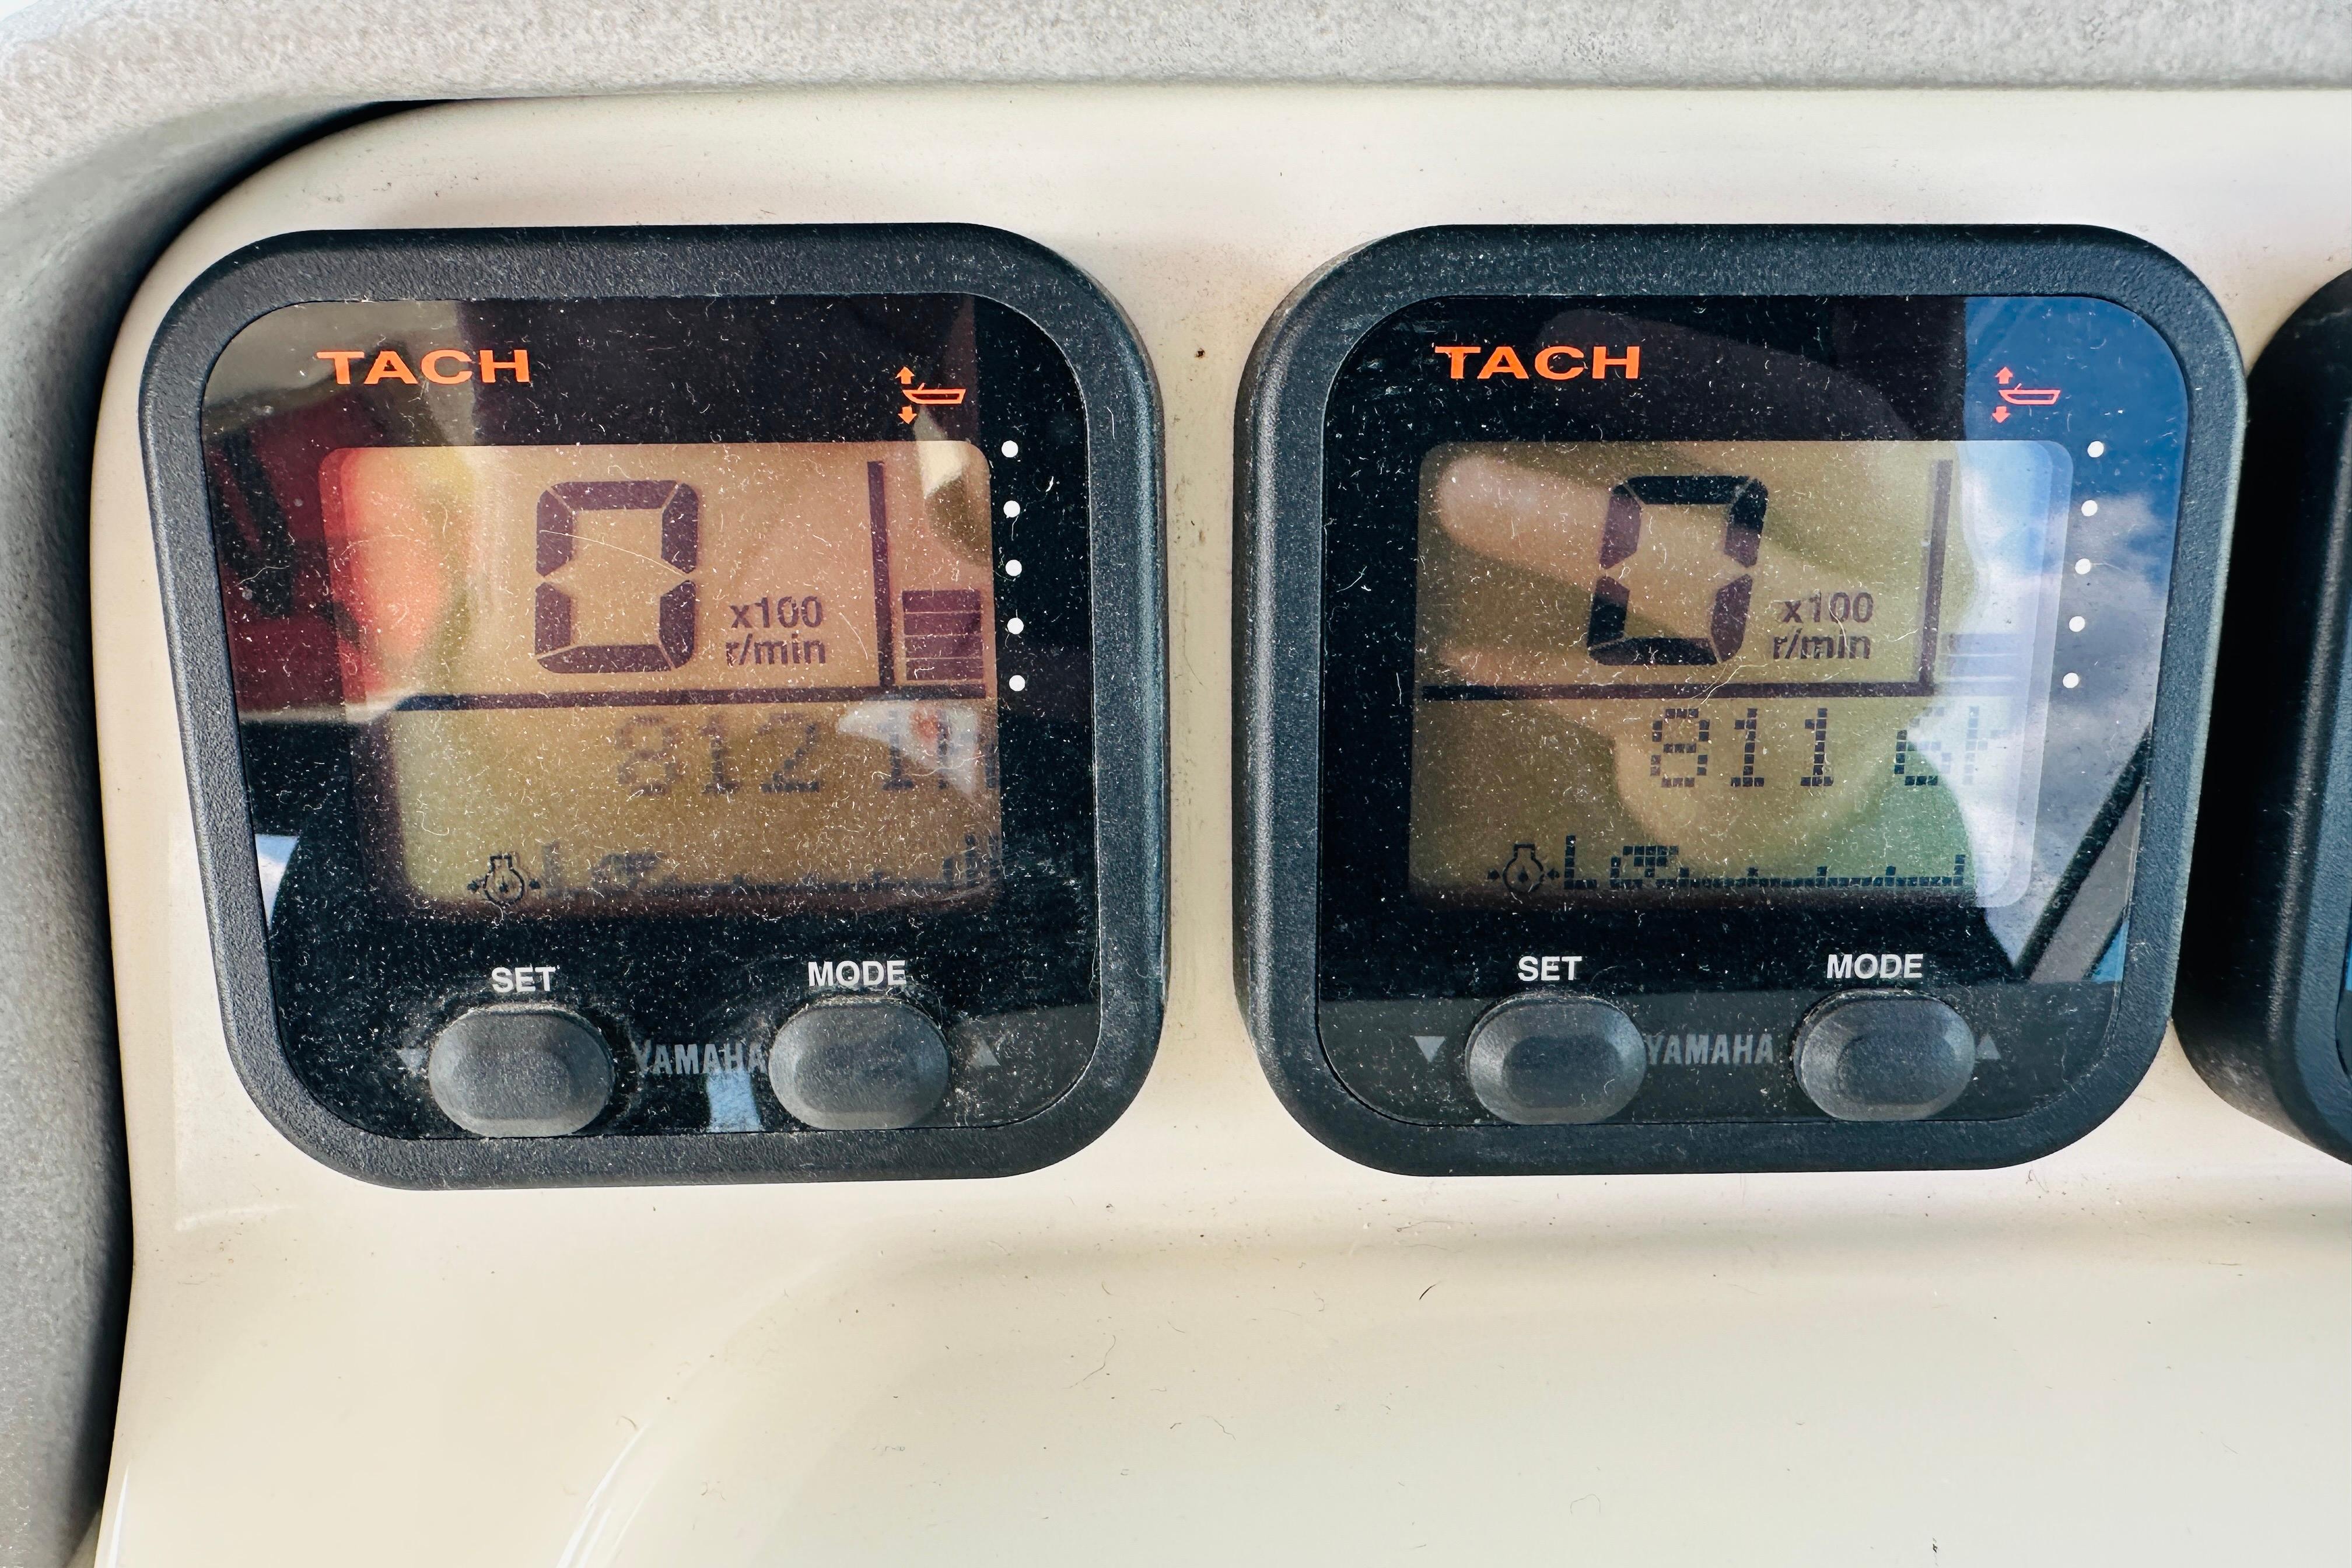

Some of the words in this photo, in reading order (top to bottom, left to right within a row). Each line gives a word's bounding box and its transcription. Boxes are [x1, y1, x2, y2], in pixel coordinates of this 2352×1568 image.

[317, 349, 531, 385] TACH
[1434, 344, 1642, 380] TACH
[535, 480, 700, 675] 0
[1586, 474, 1769, 666] 0
[730, 595, 823, 630] x100
[1782, 591, 1874, 626] x100
[725, 633, 827, 667] r/min
[1772, 628, 1872, 662] r/min
[1650, 707, 1835, 788] 811
[491, 966, 555, 994] SET
[808, 960, 908, 987] MODE
[1517, 956, 1582, 982] SET
[1826, 953, 1924, 980] MODE
[630, 1039, 768, 1074] YAMAHA
[1645, 1033, 1774, 1065] YAMAHA
